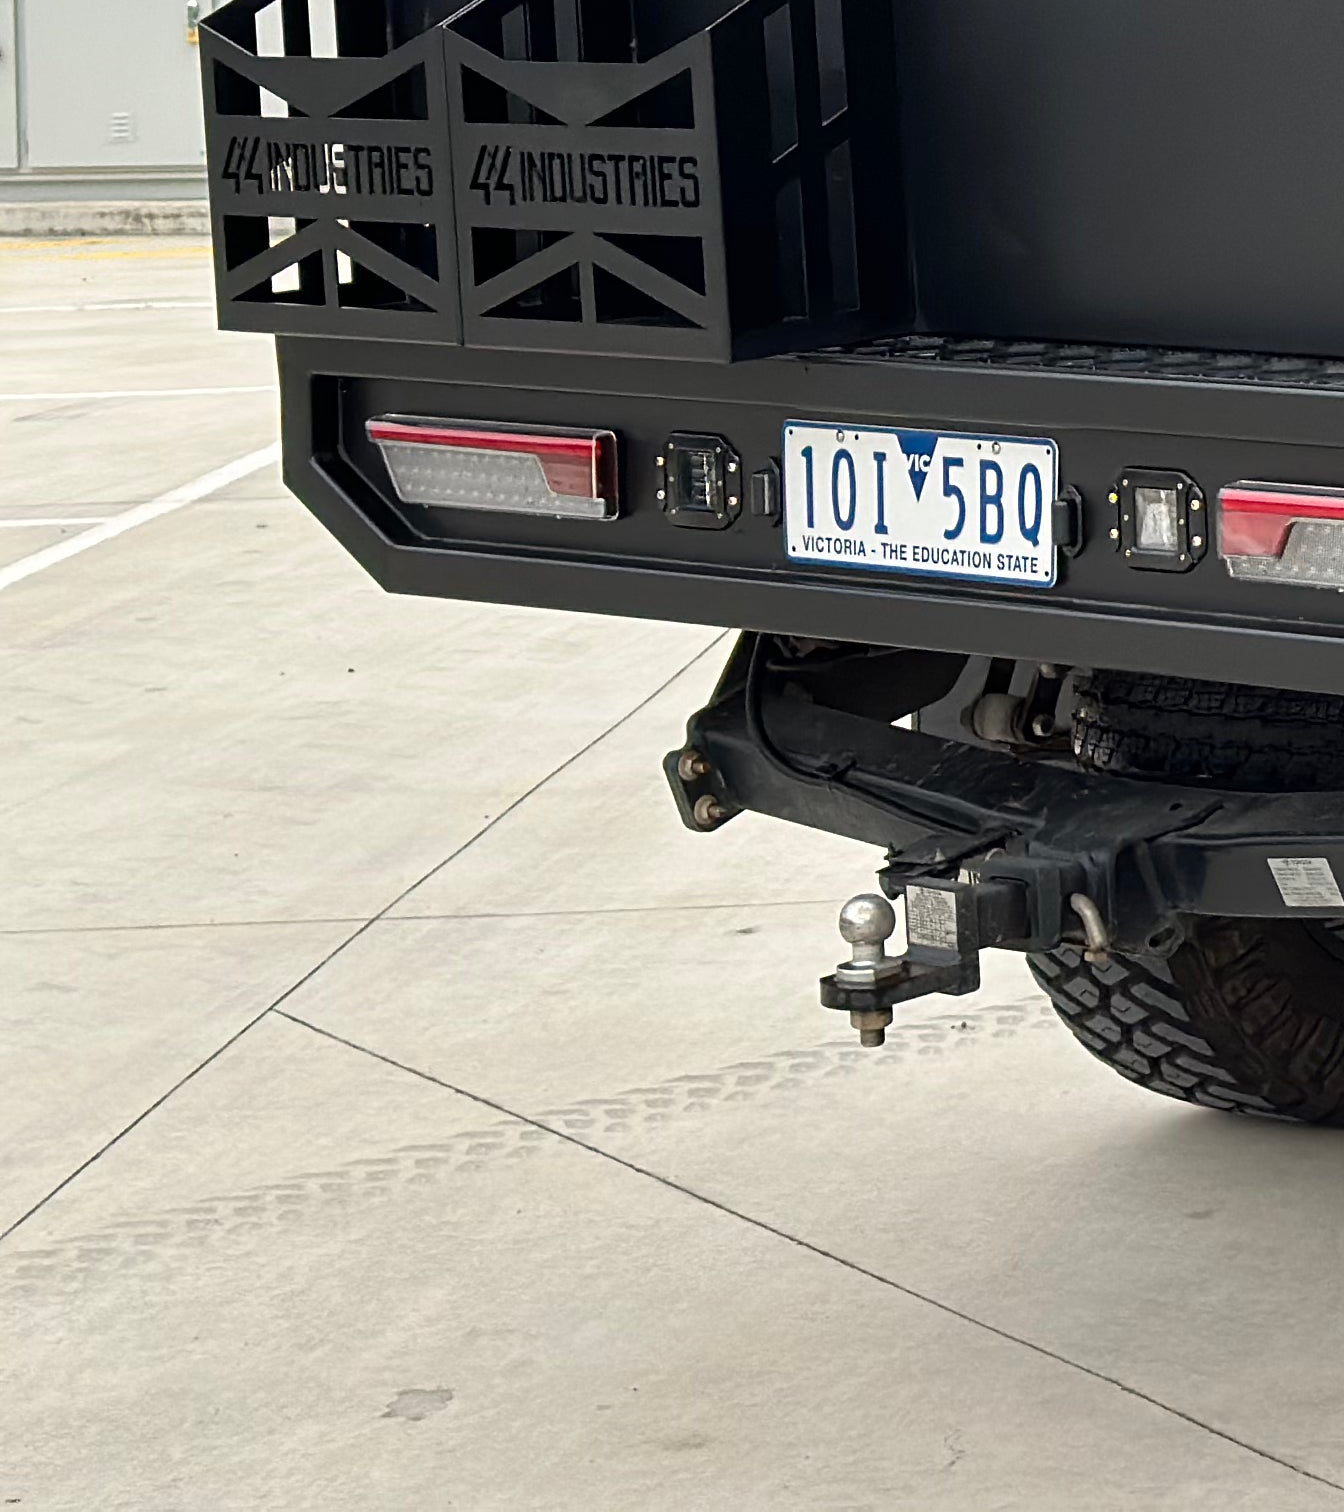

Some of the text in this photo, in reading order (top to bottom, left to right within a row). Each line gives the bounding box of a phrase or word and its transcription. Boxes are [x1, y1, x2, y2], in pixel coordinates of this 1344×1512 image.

[267, 141, 434, 197] INDUSTRIES
[519, 151, 700, 208] INDUSTRIES
[902, 453, 931, 473] VIC
[942, 456, 1043, 548] 5BQ
[802, 535, 867, 557] VICTORIA
[881, 542, 908, 561] THE
[912, 545, 992, 569] EDUCATION
[997, 553, 1039, 573] STATE
